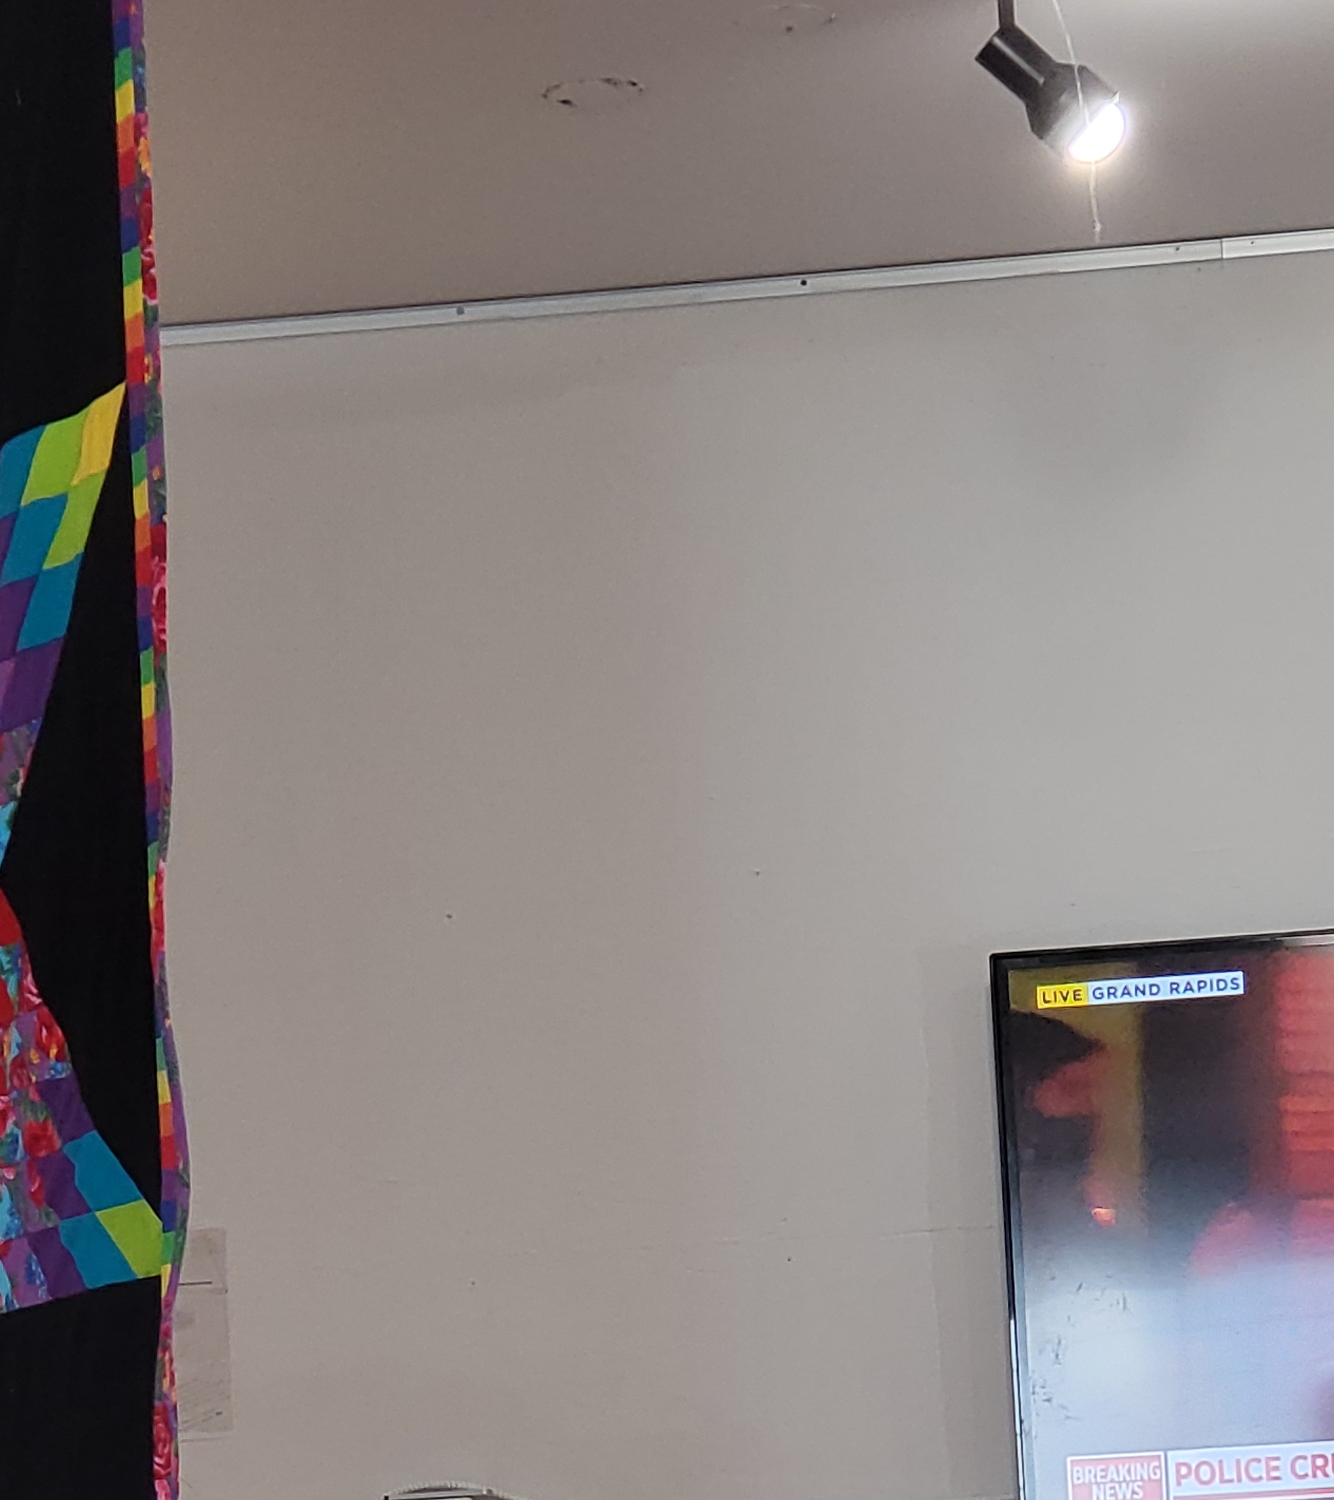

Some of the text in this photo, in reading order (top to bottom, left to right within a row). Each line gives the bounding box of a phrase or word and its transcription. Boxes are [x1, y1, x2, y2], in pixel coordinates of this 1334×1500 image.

[1042, 977, 1240, 1004] LIVE GRAND RAPIDS
[1072, 1461, 1161, 1484] BREAKING
[1175, 1456, 1282, 1487] POLICE
[1092, 1481, 1145, 1500] NEWS
